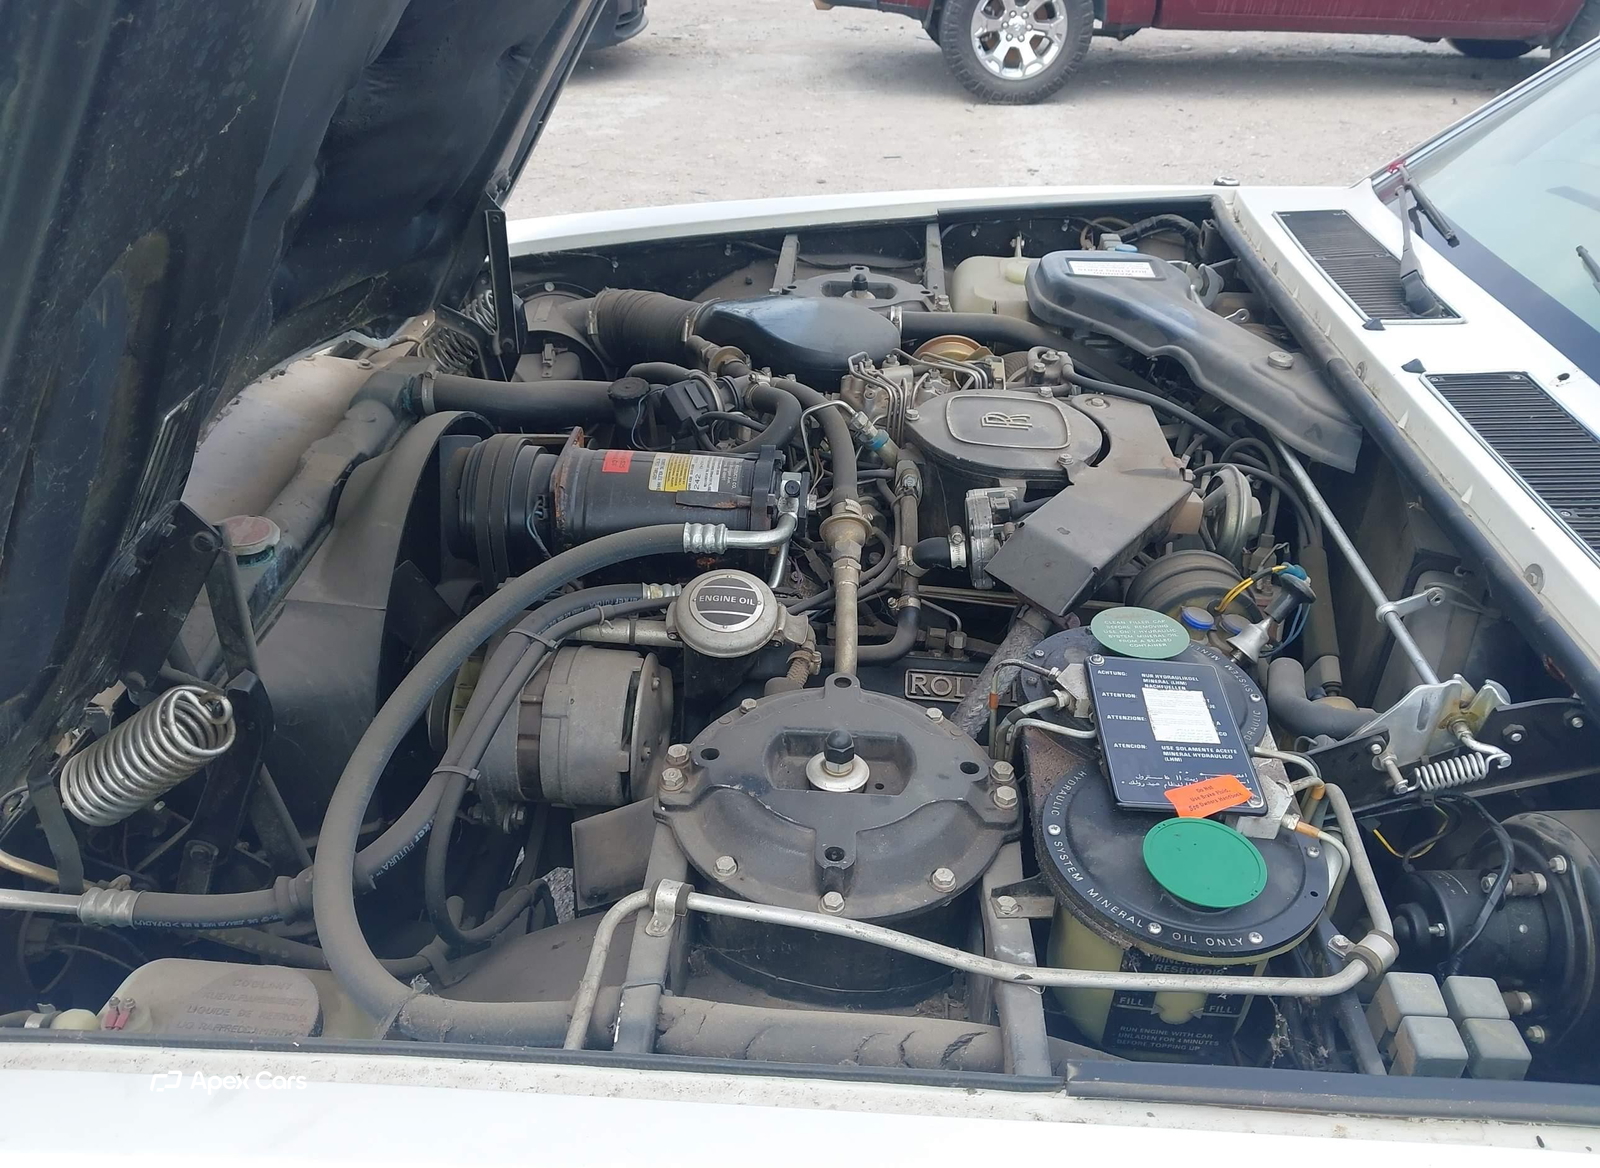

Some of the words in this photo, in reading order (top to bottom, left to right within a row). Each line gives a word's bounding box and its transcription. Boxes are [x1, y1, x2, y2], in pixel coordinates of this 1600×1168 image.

[699, 595, 737, 603] ENGINE
[739, 597, 755, 606] OIL
[1097, 669, 1128, 677] ACHTUNG:
[1224, 664, 1253, 694] SYSTEM
[910, 673, 967, 698] ROL
[1243, 709, 1261, 741] DRAULIC
[1113, 742, 1148, 750] ATENCION:
[1192, 752, 1233, 760] HYDRAULICO
[1051, 770, 1087, 816] HYDRAULIC
[1200, 792, 1216, 800] Brake
[1188, 804, 1200, 812] See
[1054, 840, 1084, 883] SYSTEM
[1087, 887, 1143, 928] MINERAL
[1172, 932, 1197, 944] OIL
[1205, 937, 1243, 947] ONLY
[1155, 964, 1225, 976] RESERVOIR
[1119, 997, 1144, 1006] FILL
[186, 1005, 232, 1017] LIQUIDE
[237, 1009, 254, 1018] DE
[1208, 1005, 1233, 1014] FILL
[1140, 1028, 1169, 1036] ENGINE
[1171, 1030, 1194, 1038] WITH
[1118, 1032, 1157, 1041] UNLADEN
[1183, 1038, 1219, 1046] MINUTES
[1151, 1042, 1187, 1050] TOPPING
